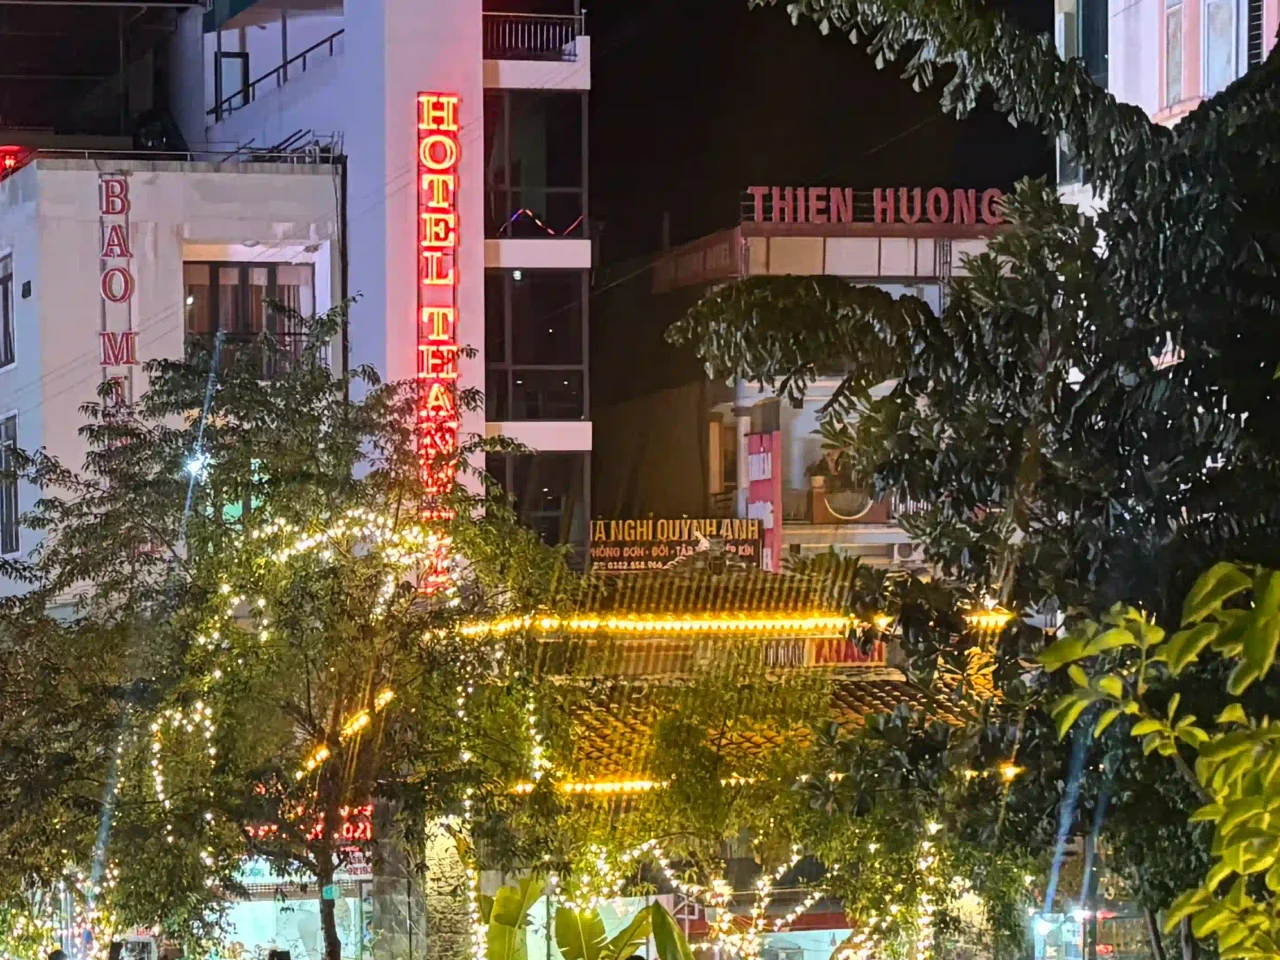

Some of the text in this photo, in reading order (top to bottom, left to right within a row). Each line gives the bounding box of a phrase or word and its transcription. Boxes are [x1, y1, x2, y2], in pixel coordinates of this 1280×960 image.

[418, 95, 459, 286] HOTEL
[747, 186, 1005, 225] THIEN HUONG
[101, 178, 135, 303] BAO
[720, 518, 759, 540] ANH
